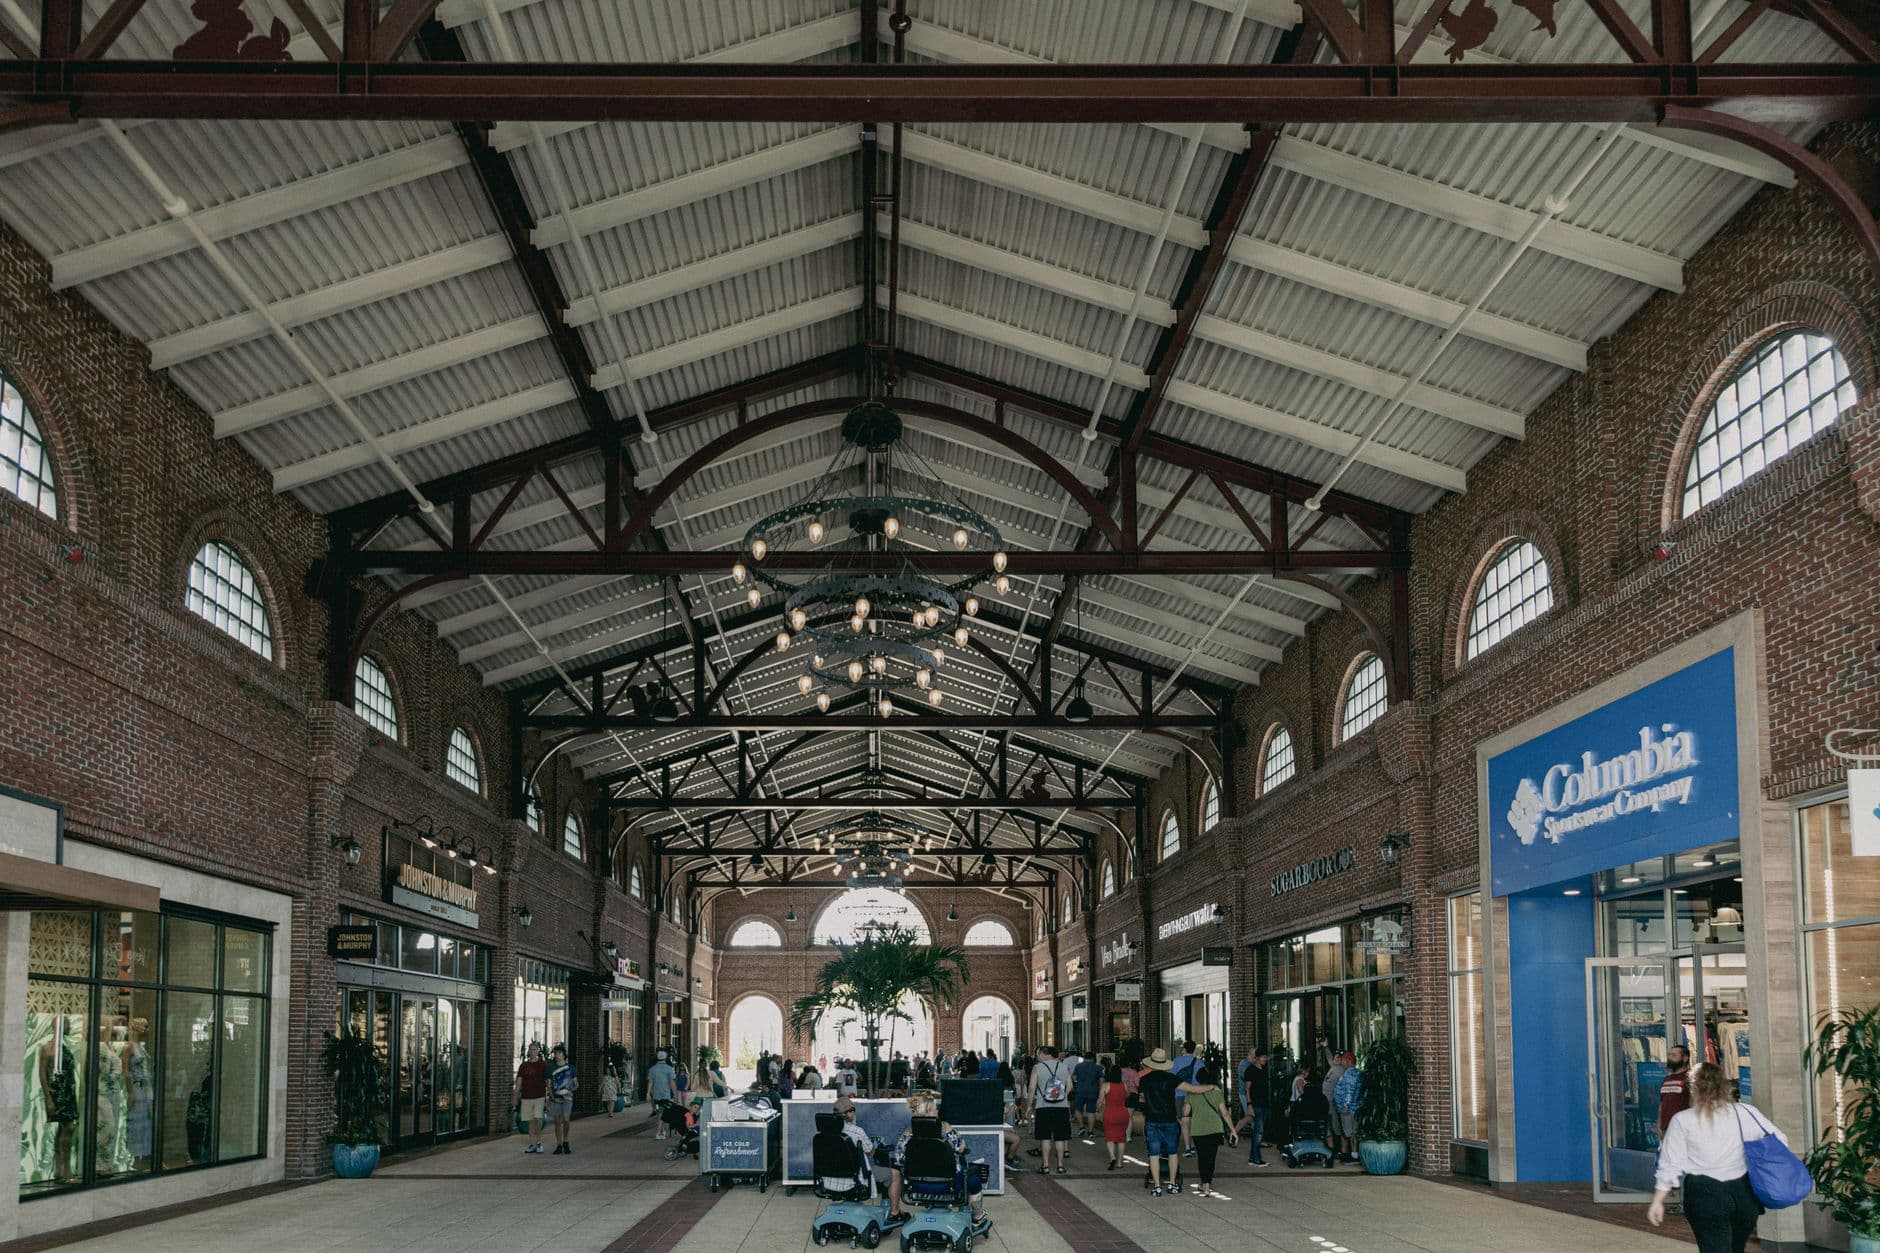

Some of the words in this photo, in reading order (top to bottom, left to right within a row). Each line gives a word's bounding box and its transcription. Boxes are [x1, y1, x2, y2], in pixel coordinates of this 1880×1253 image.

[1543, 723, 1700, 812] Columbia
[1544, 801, 1616, 844] Sportswear
[1614, 775, 1694, 815] Company
[399, 863, 442, 900] JOHNSTON
[449, 880, 477, 911] MURPHY
[337, 933, 373, 941] JOHNSTON
[343, 941, 372, 950] MURPHY
